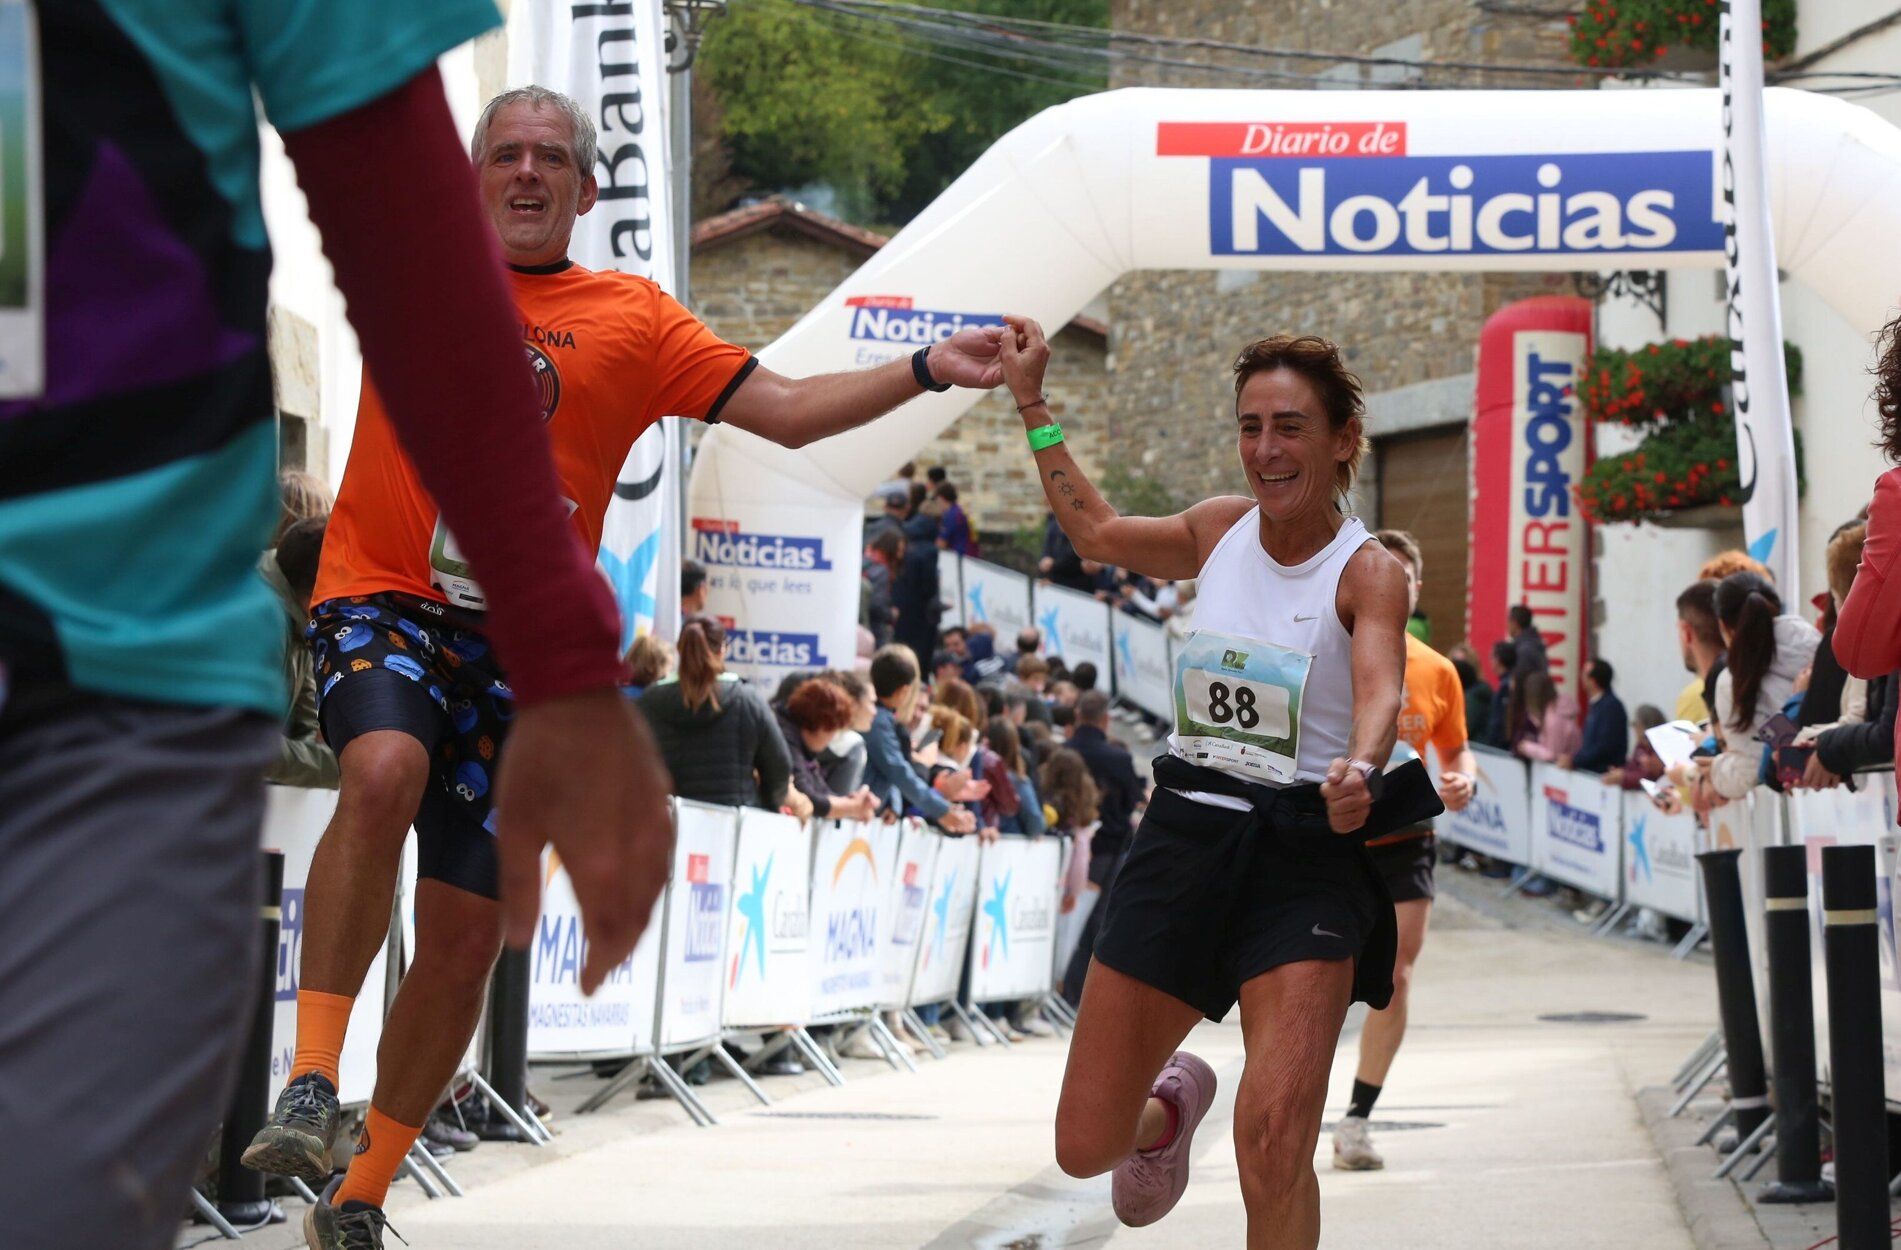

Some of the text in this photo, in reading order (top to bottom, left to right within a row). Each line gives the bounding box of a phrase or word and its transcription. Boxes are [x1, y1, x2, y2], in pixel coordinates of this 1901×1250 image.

[1240, 123, 1400, 155] Diario de
[1232, 162, 1678, 252] Noticias
[523, 323, 577, 350] LONA
[1522, 352, 1573, 684] TERSPORT
[700, 533, 816, 569] Noticias
[747, 576, 777, 594] que
[783, 577, 812, 593] lees
[1208, 681, 1260, 729] 88
